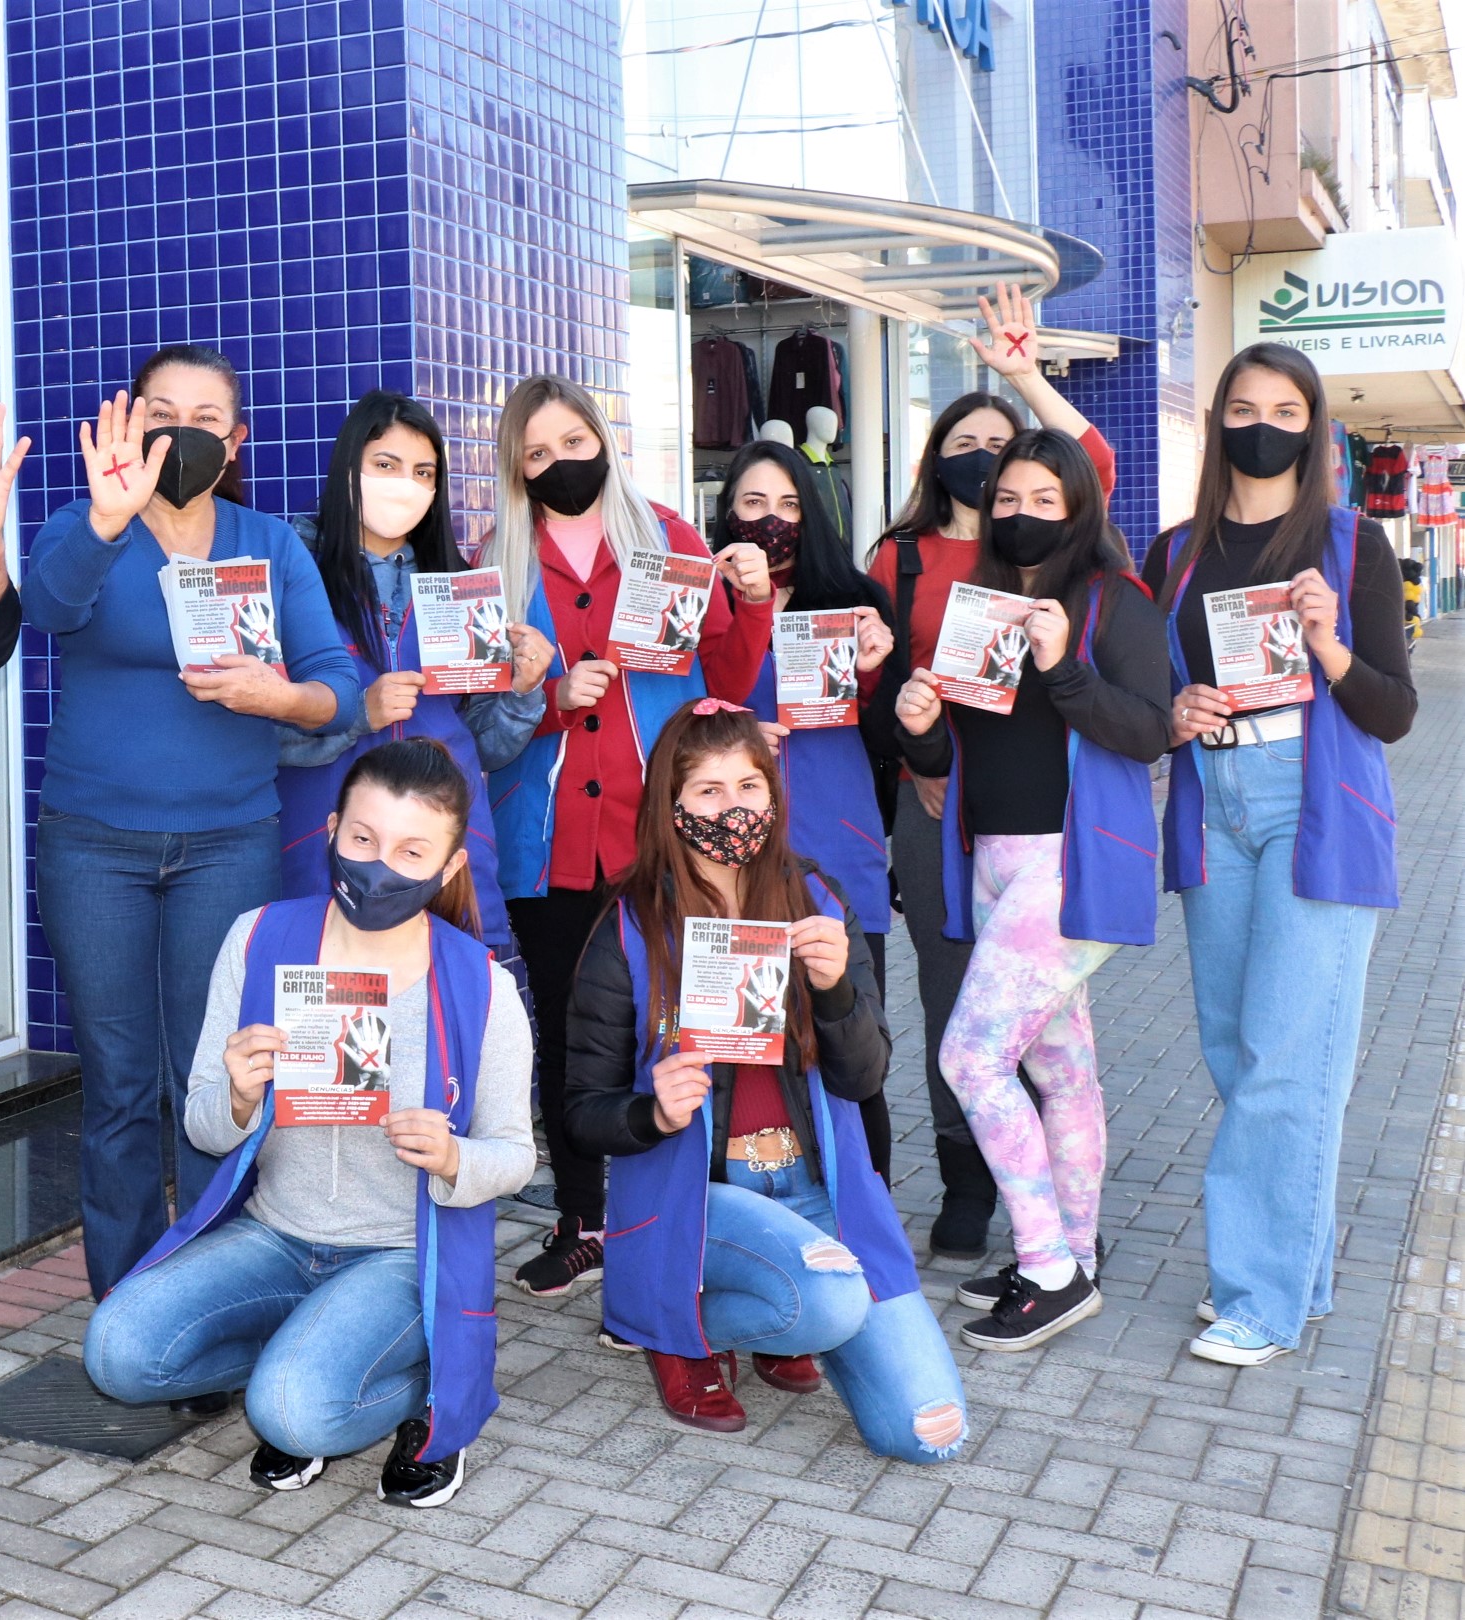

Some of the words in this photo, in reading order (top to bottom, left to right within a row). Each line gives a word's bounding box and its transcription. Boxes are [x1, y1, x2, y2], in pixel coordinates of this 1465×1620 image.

[1342, 338, 1352, 348] E
[1360, 333, 1446, 348] LIVRARIA
[633, 551, 648, 559] VOCÊ
[649, 554, 665, 562] PODE
[631, 559, 662, 572] GRITAR
[179, 568, 196, 576] VOCÊ
[645, 572, 659, 581] POR
[180, 577, 214, 588] GRITAR
[199, 589, 214, 597] POR
[418, 585, 449, 594] GRITAR
[958, 586, 973, 596] VOCÊ
[974, 590, 989, 599] PODE
[436, 594, 451, 602] POR
[1210, 594, 1226, 602] VOCÊ
[1212, 601, 1244, 613] GRITAR
[1231, 611, 1246, 619] POR
[780, 624, 809, 632] GRITAR
[693, 922, 711, 931] VOCÊ
[692, 932, 728, 943] GRITAR
[711, 945, 728, 954] POR
[284, 970, 303, 980] VOCÊ
[305, 972, 325, 980] PODE
[283, 982, 324, 994] GRITAR
[305, 996, 323, 1005] POR
